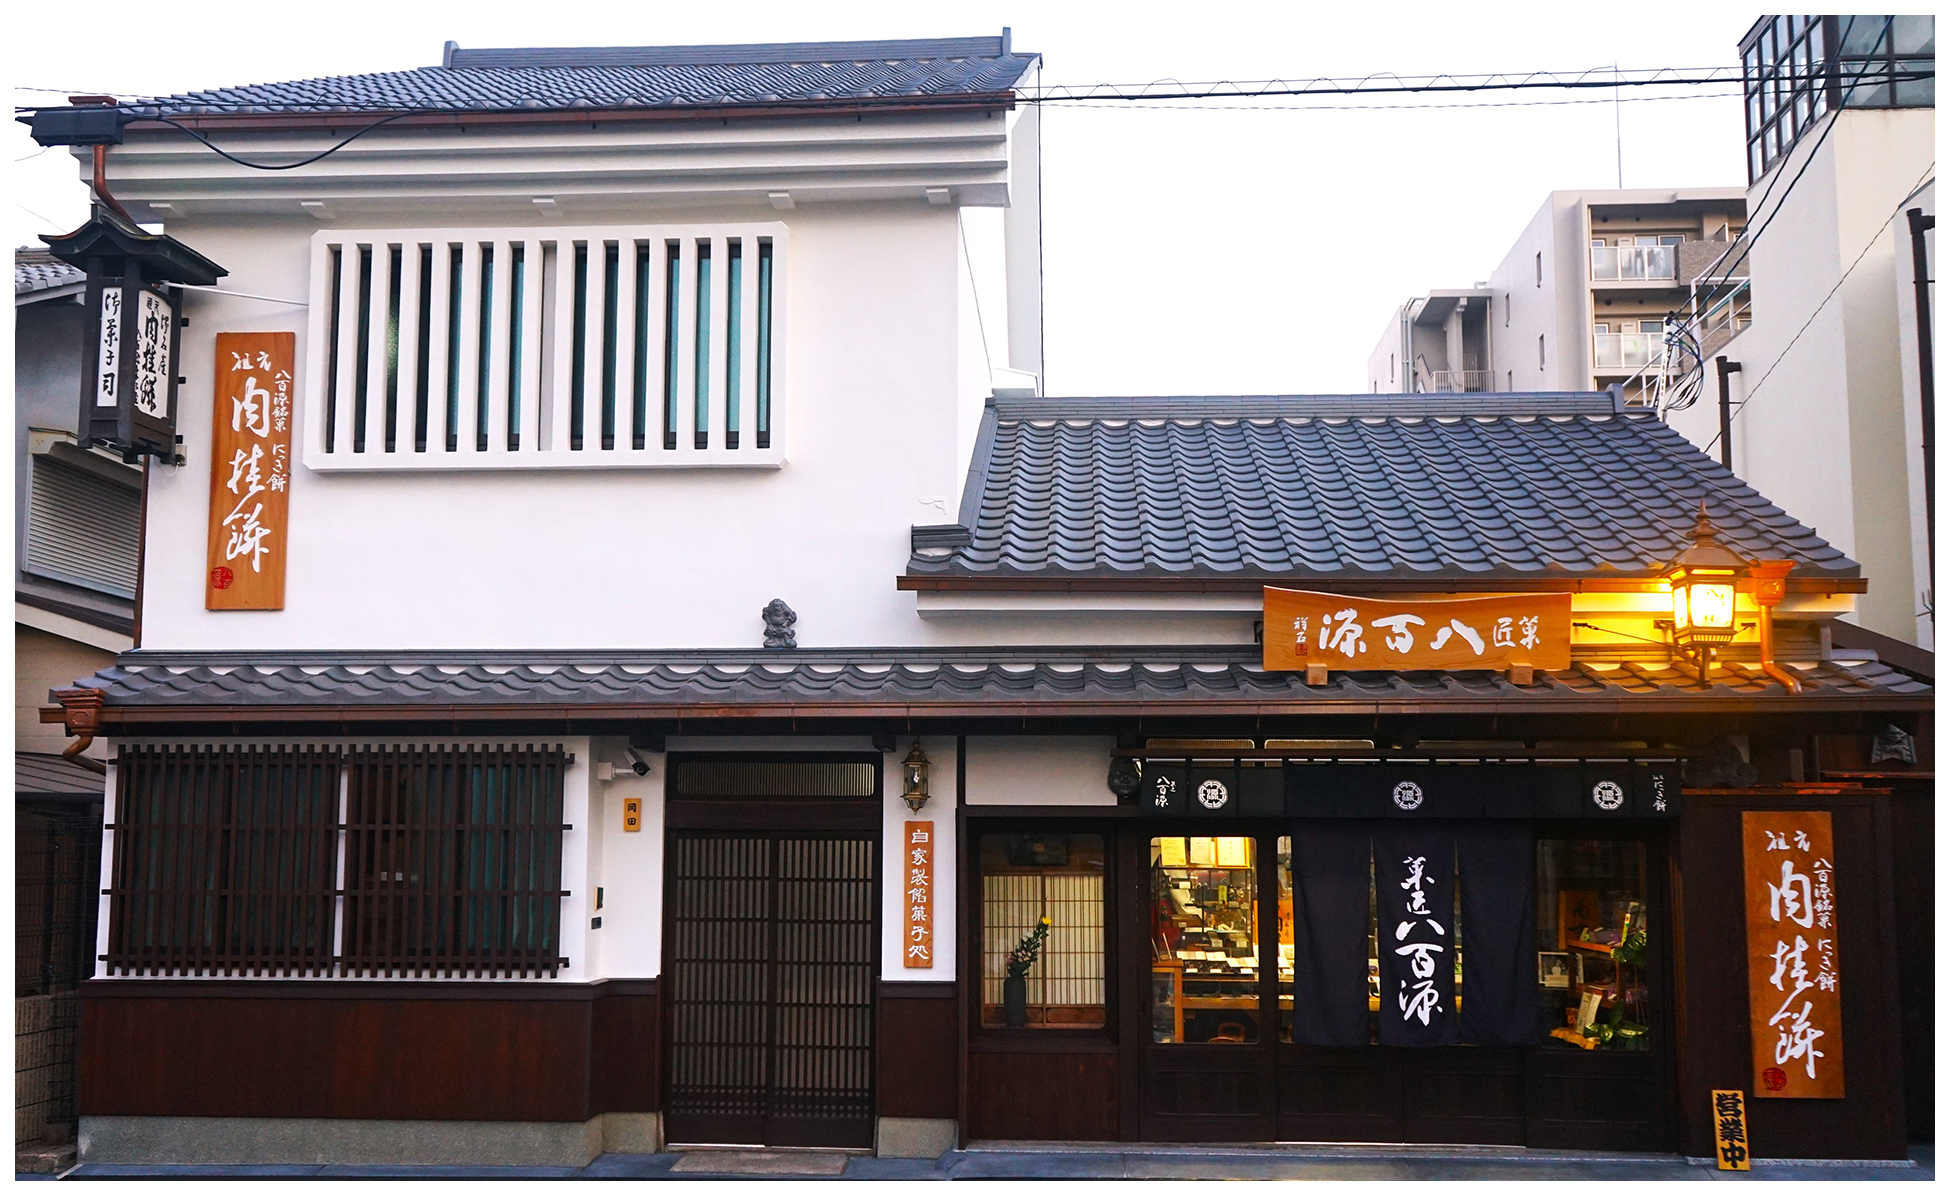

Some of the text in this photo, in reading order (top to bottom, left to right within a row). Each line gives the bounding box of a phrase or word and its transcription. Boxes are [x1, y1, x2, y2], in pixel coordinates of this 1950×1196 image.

[223, 376, 272, 574] 肉桂餅
[265, 443, 288, 494] にっき餅
[627, 802, 637, 826] 岡田
[1154, 775, 1170, 808] 八百源
[1767, 859, 1825, 1081] 肉桂餅
[1814, 938, 1837, 993] にっき餅
[1715, 1093, 1747, 1169] 営業中
